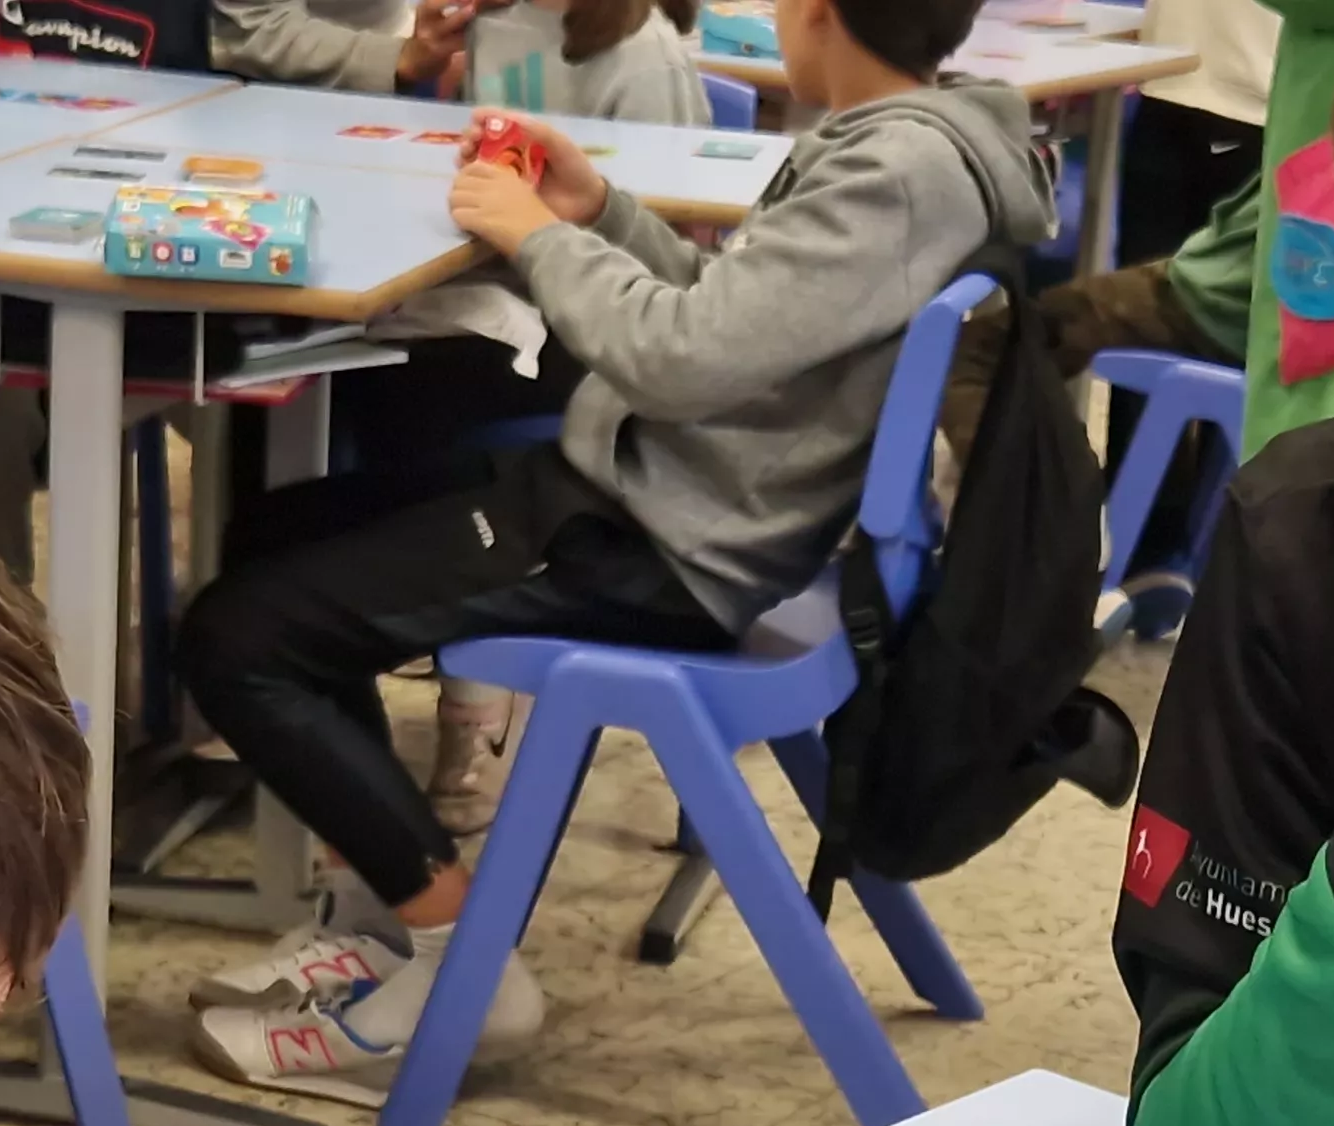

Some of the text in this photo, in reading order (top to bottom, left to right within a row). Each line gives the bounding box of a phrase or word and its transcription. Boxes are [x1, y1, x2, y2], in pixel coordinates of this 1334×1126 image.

[1190, 840, 1287, 904] Ayuntam
[1175, 880, 1273, 937] de Hues
